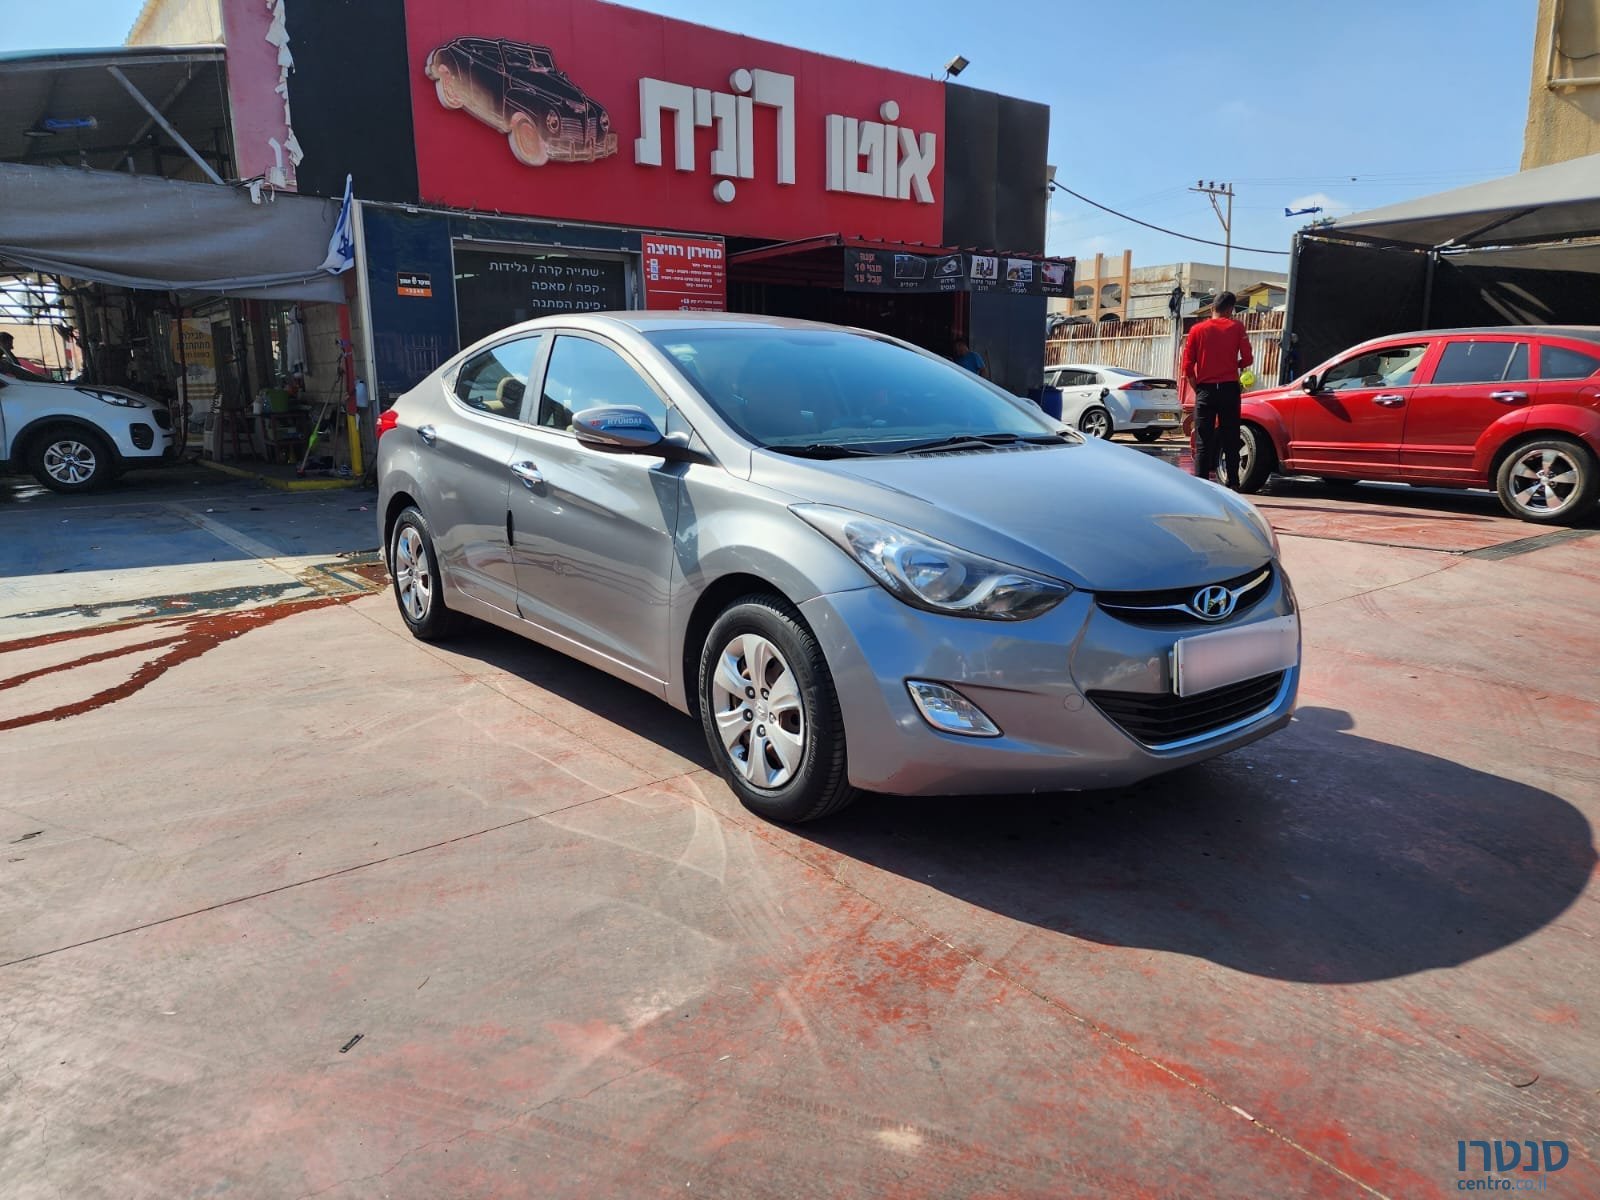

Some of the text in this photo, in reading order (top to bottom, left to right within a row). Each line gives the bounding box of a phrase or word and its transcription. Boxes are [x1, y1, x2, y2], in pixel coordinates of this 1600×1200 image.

[646, 242, 722, 260] מחירון רחיצה
[489, 261, 529, 272] גלידות
[539, 265, 563, 277] קרה
[566, 267, 600, 277] שתייה
[531, 281, 566, 291] מאפה
[576, 283, 600, 295] קפה
[532, 299, 601, 310] פינת המתנה
[607, 417, 642, 425] HYUNDAI
